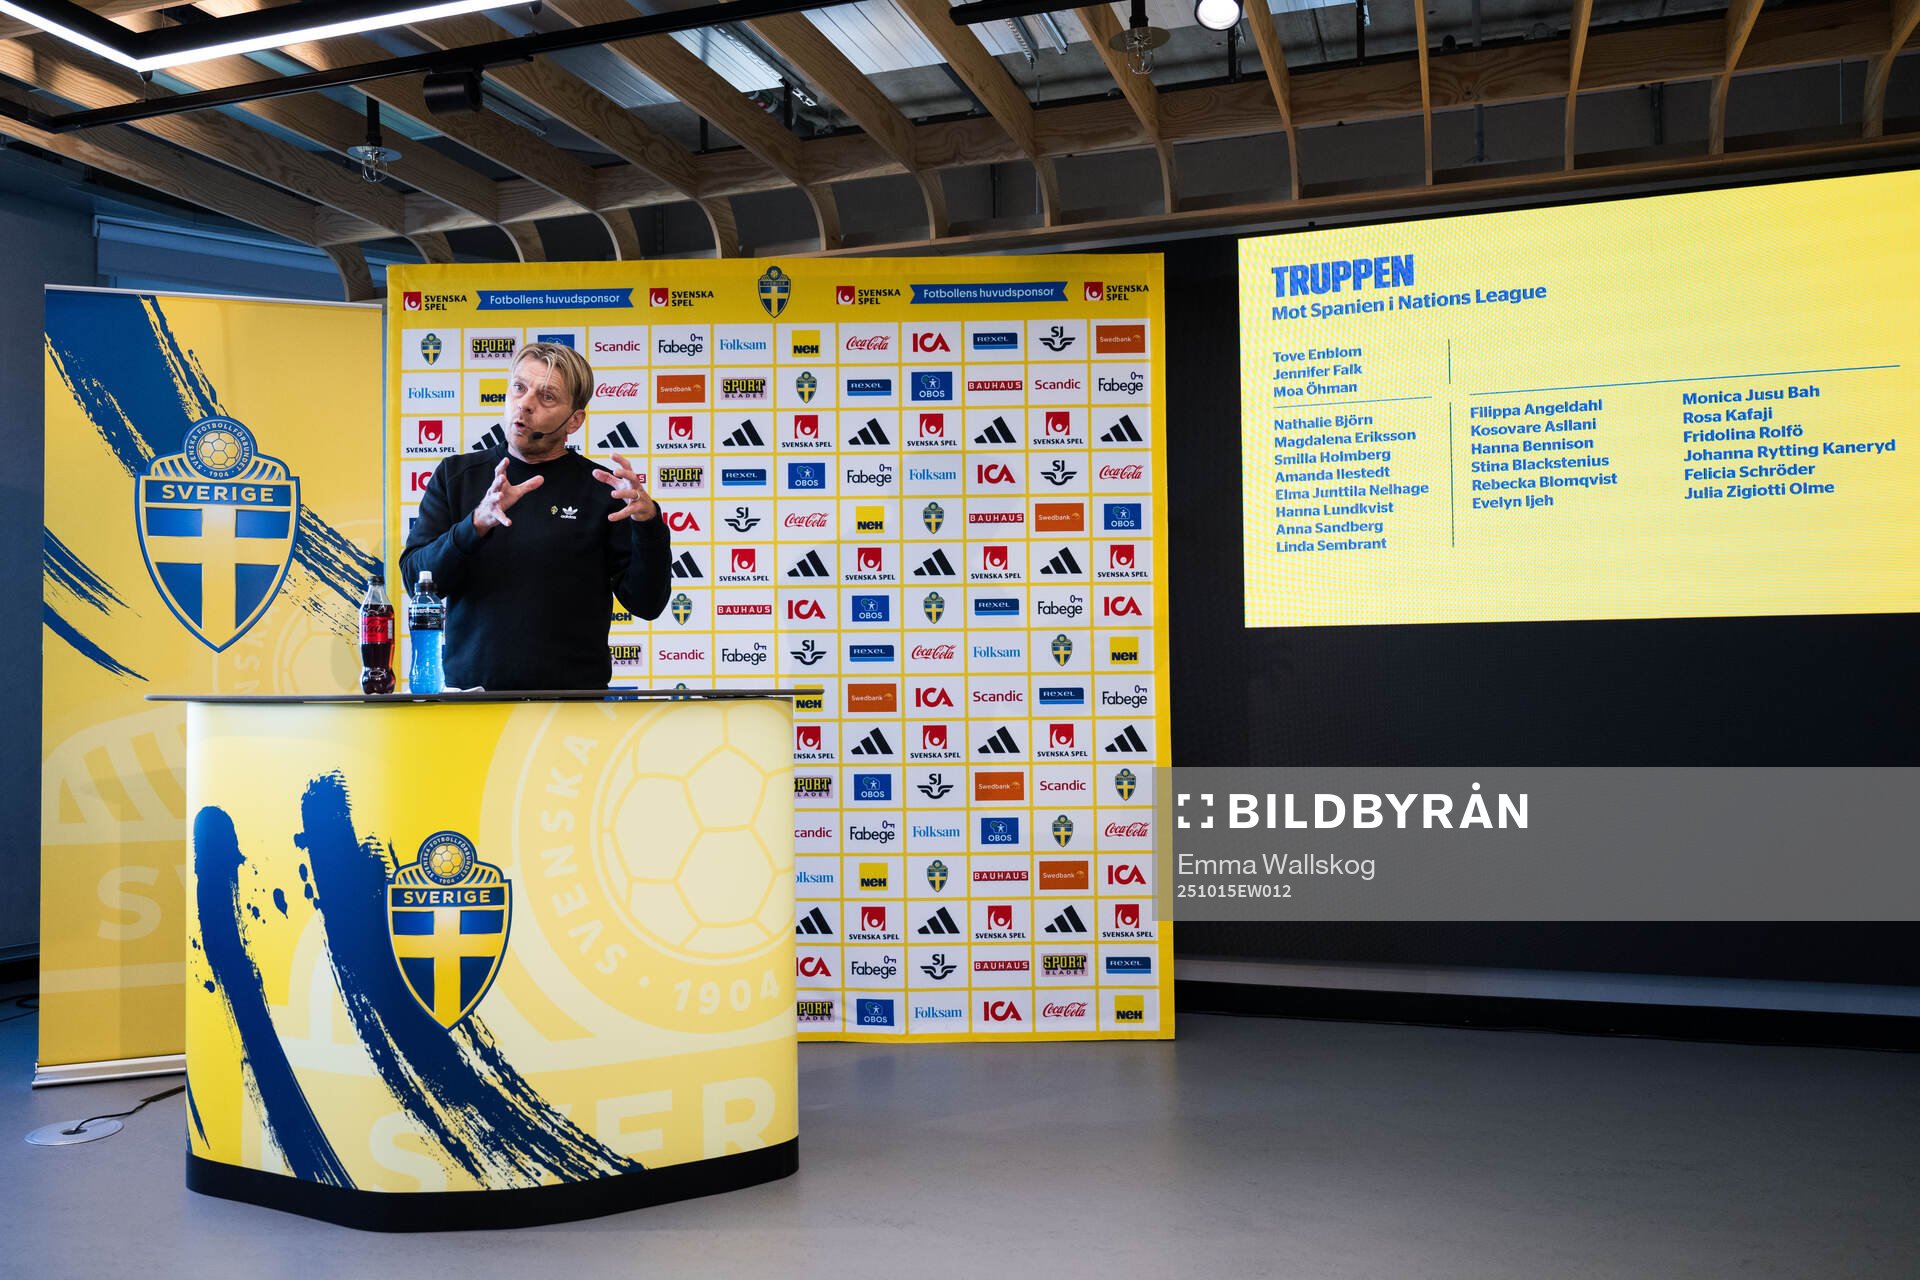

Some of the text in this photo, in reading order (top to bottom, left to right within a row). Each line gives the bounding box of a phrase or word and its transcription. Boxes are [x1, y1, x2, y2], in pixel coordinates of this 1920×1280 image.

[1271, 254, 1415, 298] TRUPPEN
[672, 290, 714, 299] SVENSKA
[858, 288, 901, 297] SVENSKA
[924, 286, 1054, 300] Fotbollens huvudsponsor
[1106, 284, 1149, 293] SVENSKA
[424, 294, 467, 303] SVENSKA
[490, 293, 620, 306] Fotbollens huvudsponsor
[672, 299, 694, 307] SPEL
[858, 297, 881, 305] SPEL
[1106, 293, 1129, 301] SPEL
[1272, 285, 1547, 321] Mot Spanien i Nations League
[424, 303, 447, 311] SPEL
[1051, 326, 1064, 338] SJ
[472, 338, 515, 353] SPORT
[594, 340, 640, 352] Scandic
[658, 339, 703, 356] Fabege
[720, 339, 766, 351] Folksam
[912, 333, 951, 353] ICA
[1273, 347, 1362, 363] Tove Enblom
[1273, 363, 1363, 380] Jennifer Falk
[723, 379, 765, 393] SPORT
[968, 381, 1022, 390] BAUHAUS
[1034, 379, 1081, 390] Scandic
[1098, 377, 1144, 395] Fabege
[1273, 382, 1357, 397] Moa Öhman
[408, 387, 455, 399] Folksam
[919, 390, 945, 398] OBOS
[1683, 385, 1820, 406] Monica Jusu Bah
[1470, 399, 1603, 420] Filippa Angeldahl
[1683, 406, 1773, 424] Rosa Kafaji
[1274, 415, 1373, 430] Nathalie Björn
[1471, 418, 1596, 437] Kosovare Asllani
[1274, 430, 1416, 449] Magdalena Eriksson
[1684, 424, 1803, 443] Fridolina Rolfö
[188, 423, 250, 471] SVENSKA FOTBOLLFÖRBUNDET
[1471, 437, 1594, 455] Hanna Bennison
[1684, 438, 1896, 462] Johanna Rytting Kaneryd
[1275, 449, 1391, 465] Smilla Holmberg
[1471, 455, 1609, 473] Stina Blackstenius
[660, 468, 702, 482] SPORT
[847, 470, 892, 487] Fabege
[909, 469, 956, 480] Folksam
[977, 464, 1016, 484] ICA
[1275, 466, 1390, 483] Amanda Ilestedt
[1685, 462, 1815, 480] Felicia Schröder
[795, 479, 819, 487] OBOS
[1472, 473, 1618, 491] Rebecka Blomqvist
[162, 483, 275, 503] SVERIGE
[1275, 483, 1429, 500] Elma Junttila Nelhage
[1685, 481, 1834, 500] Julia Zigiotti Olme
[1276, 501, 1394, 518] Hanna Lundkvist
[1472, 494, 1554, 511] Evelyn Ijeh
[736, 507, 749, 519] SJ
[970, 513, 1023, 522] BAUHAUS
[1111, 519, 1135, 528] OBOS
[1276, 520, 1384, 535] Anna Sandberg
[1277, 538, 1387, 553] Linda Sembrant
[718, 605, 771, 614] BAUHAUS
[788, 599, 825, 620] ICA
[1037, 601, 1083, 618] Fabege
[1104, 596, 1142, 616] ICA
[859, 611, 883, 620] OBOS
[802, 640, 815, 652] SJ
[973, 646, 1021, 658] Folksam
[658, 649, 705, 661] Scandic
[722, 649, 767, 666] Fabege
[916, 687, 954, 707] ICA
[973, 690, 1023, 703] Scandic
[1102, 691, 1147, 709] Fabege
[1040, 779, 1086, 791] Scandic
[861, 790, 885, 798] OBOS
[794, 827, 832, 838] candic
[850, 826, 895, 844] Fabege
[913, 826, 960, 838] Folksam
[988, 834, 1012, 842] OBOS
[541, 734, 628, 977] SVENSKA
[974, 871, 1028, 881] BAUHAUS
[1108, 864, 1147, 885] ICA
[403, 890, 491, 904] SVERIGE
[932, 954, 945, 965] SJ
[974, 961, 1029, 971] BAUHAUS
[1043, 955, 1087, 970] SPORT
[851, 961, 897, 979] Fabege
[672, 968, 780, 1015] 1904
[914, 1007, 962, 1019] Folksam
[984, 1001, 1022, 1021] ICA
[864, 1015, 888, 1023] OBOS
